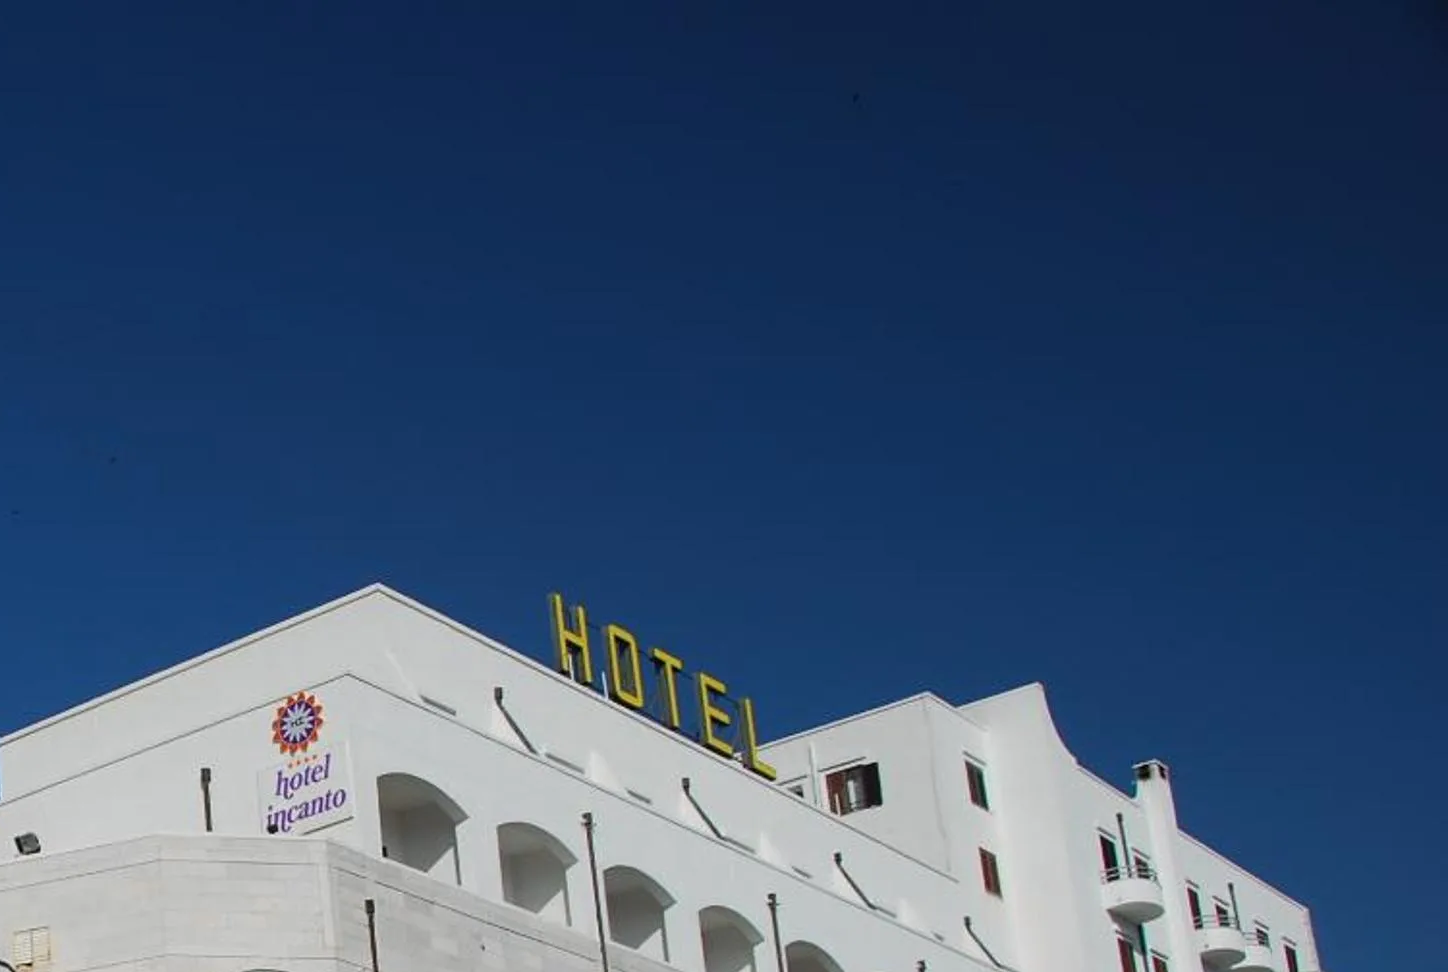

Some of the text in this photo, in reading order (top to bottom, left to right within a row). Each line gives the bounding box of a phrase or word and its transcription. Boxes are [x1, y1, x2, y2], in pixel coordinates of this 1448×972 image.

[550, 593, 777, 780] HOTEL
[274, 754, 331, 799] hotel
[266, 788, 347, 833] incanto
